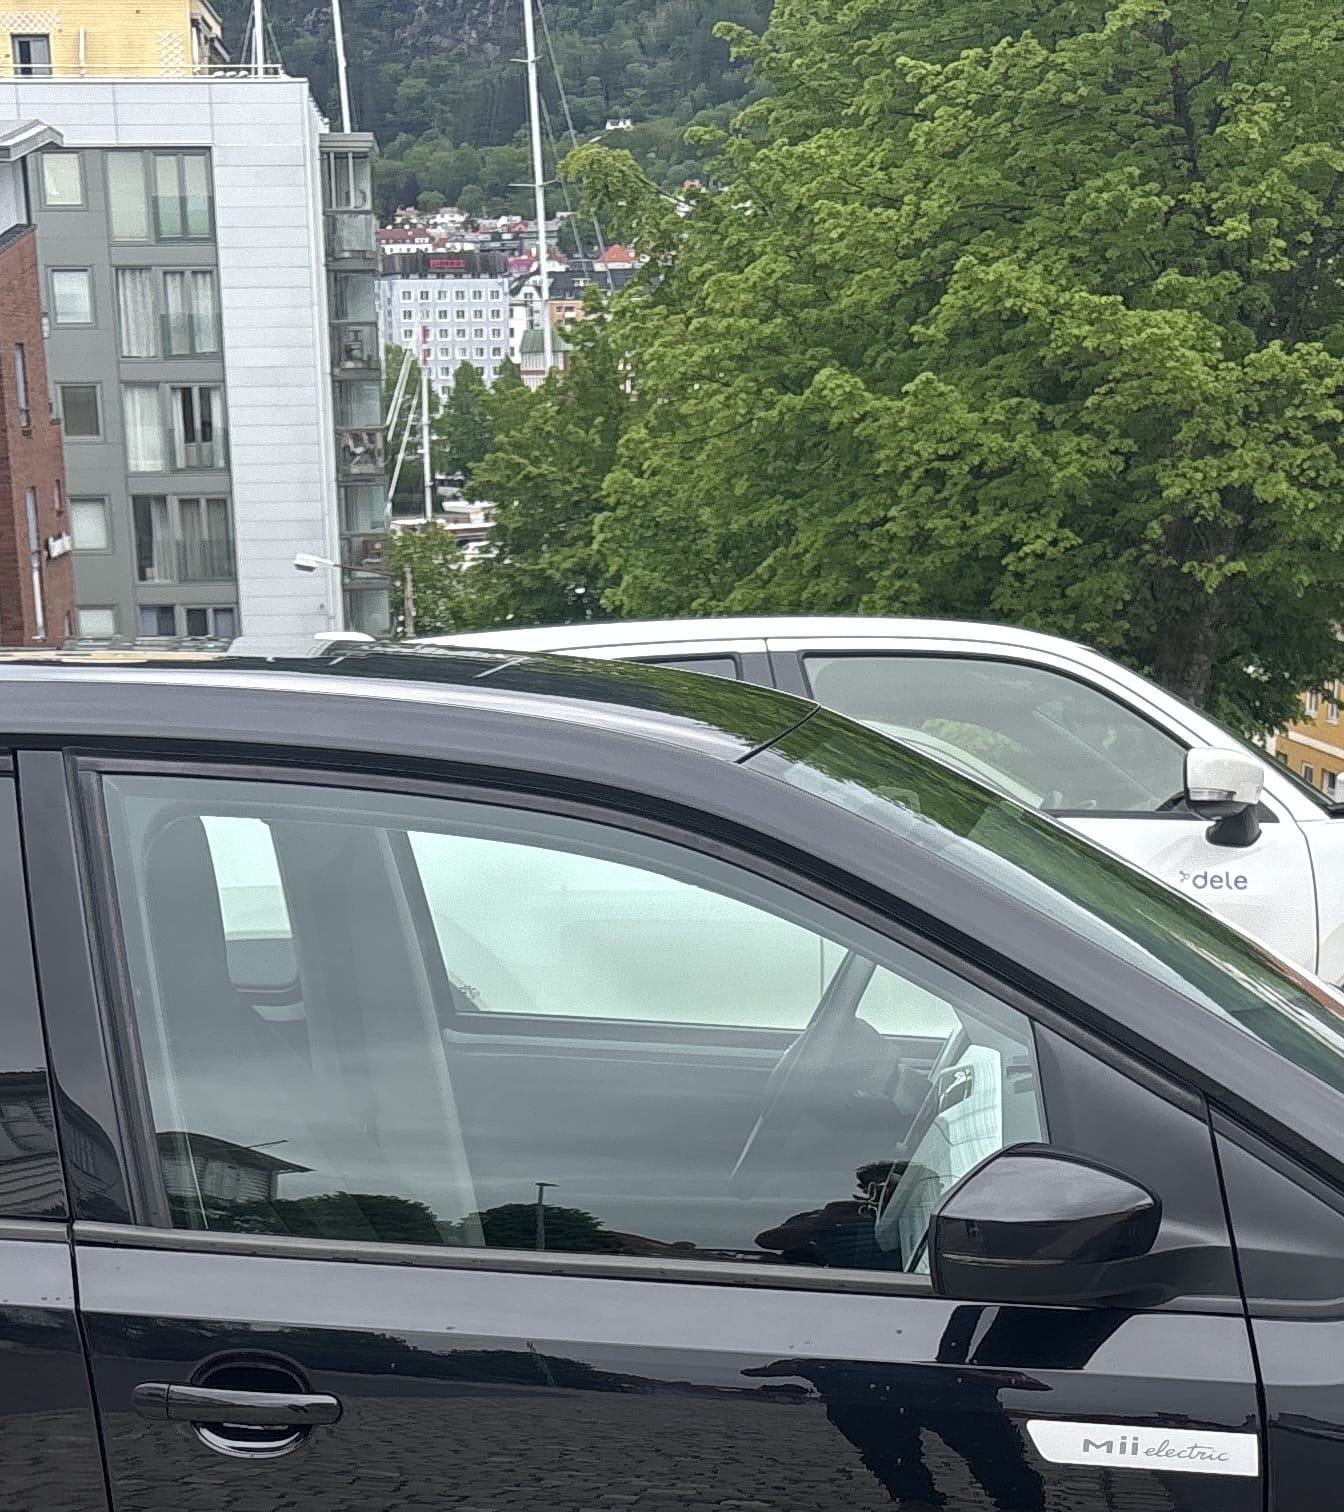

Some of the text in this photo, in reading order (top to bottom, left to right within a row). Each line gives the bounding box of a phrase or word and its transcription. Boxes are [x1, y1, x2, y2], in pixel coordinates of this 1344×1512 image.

[1192, 871, 1248, 891] dele
[1083, 1436, 1229, 1462] Mii electric
